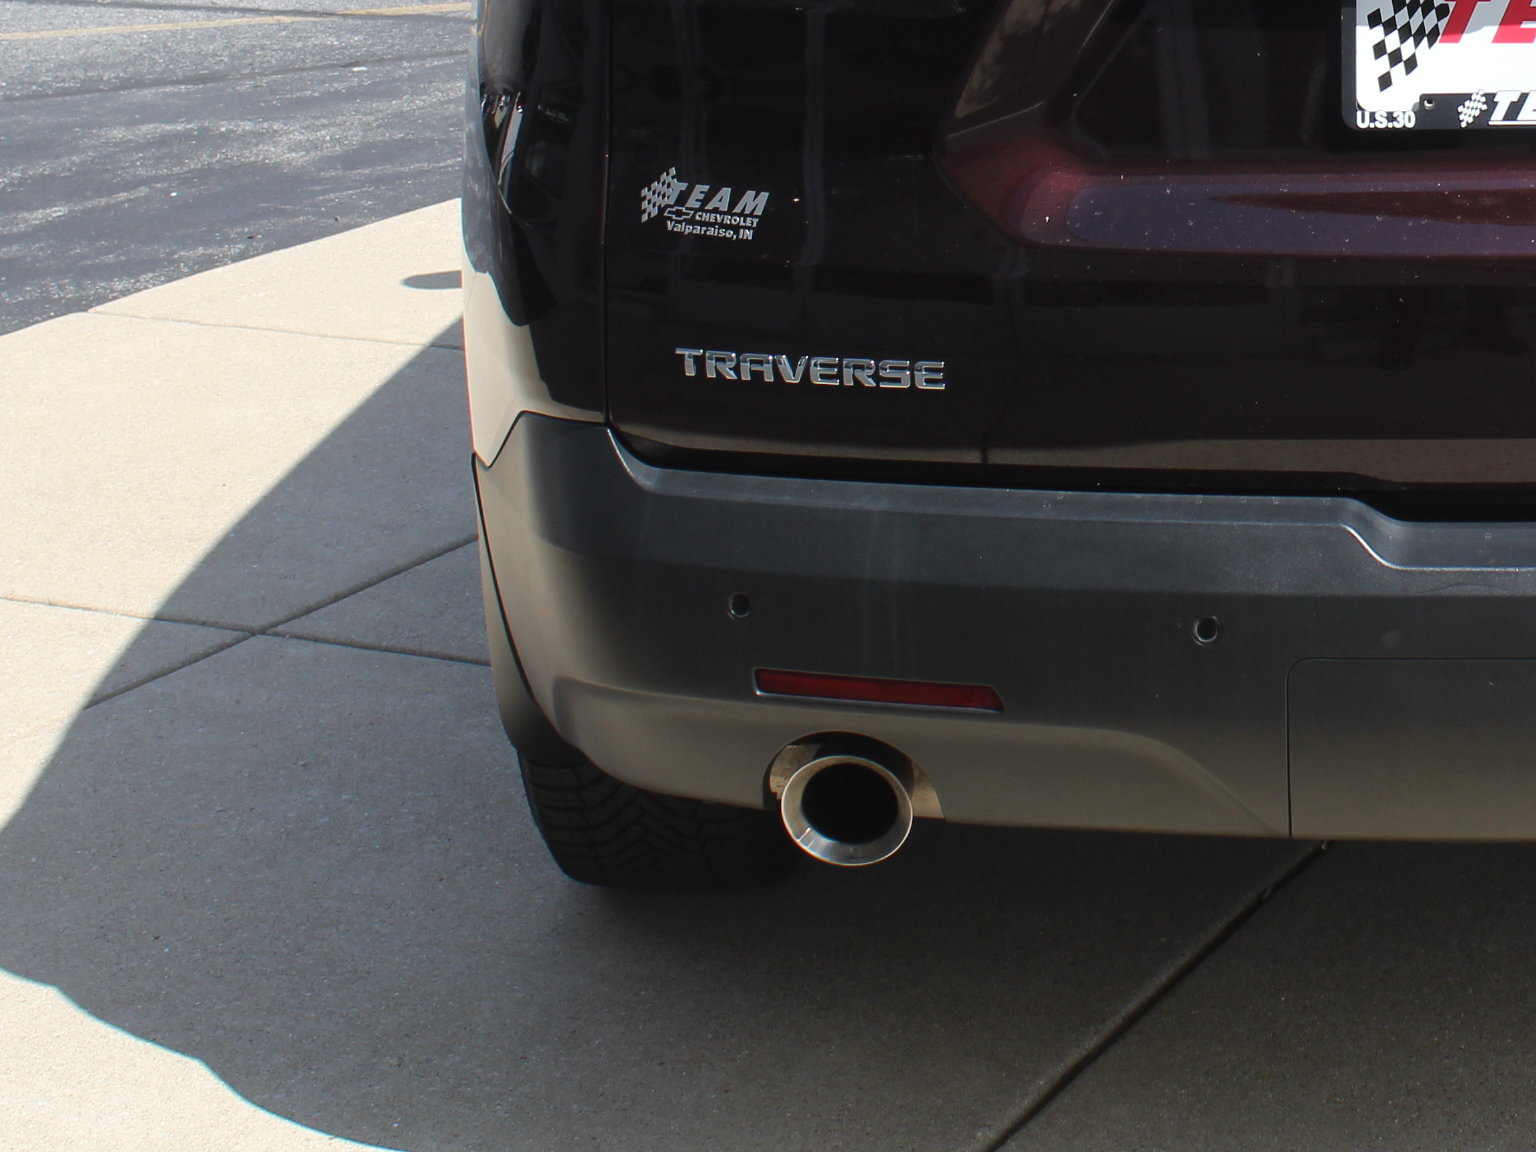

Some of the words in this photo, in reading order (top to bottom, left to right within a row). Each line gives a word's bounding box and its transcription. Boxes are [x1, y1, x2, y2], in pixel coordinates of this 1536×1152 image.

[666, 181, 769, 216] TEAM
[666, 220, 737, 241] Valparaiso,
[738, 228, 754, 240] IN
[695, 211, 759, 228] CHEVROLET
[675, 347, 946, 390] TRAVERSE
